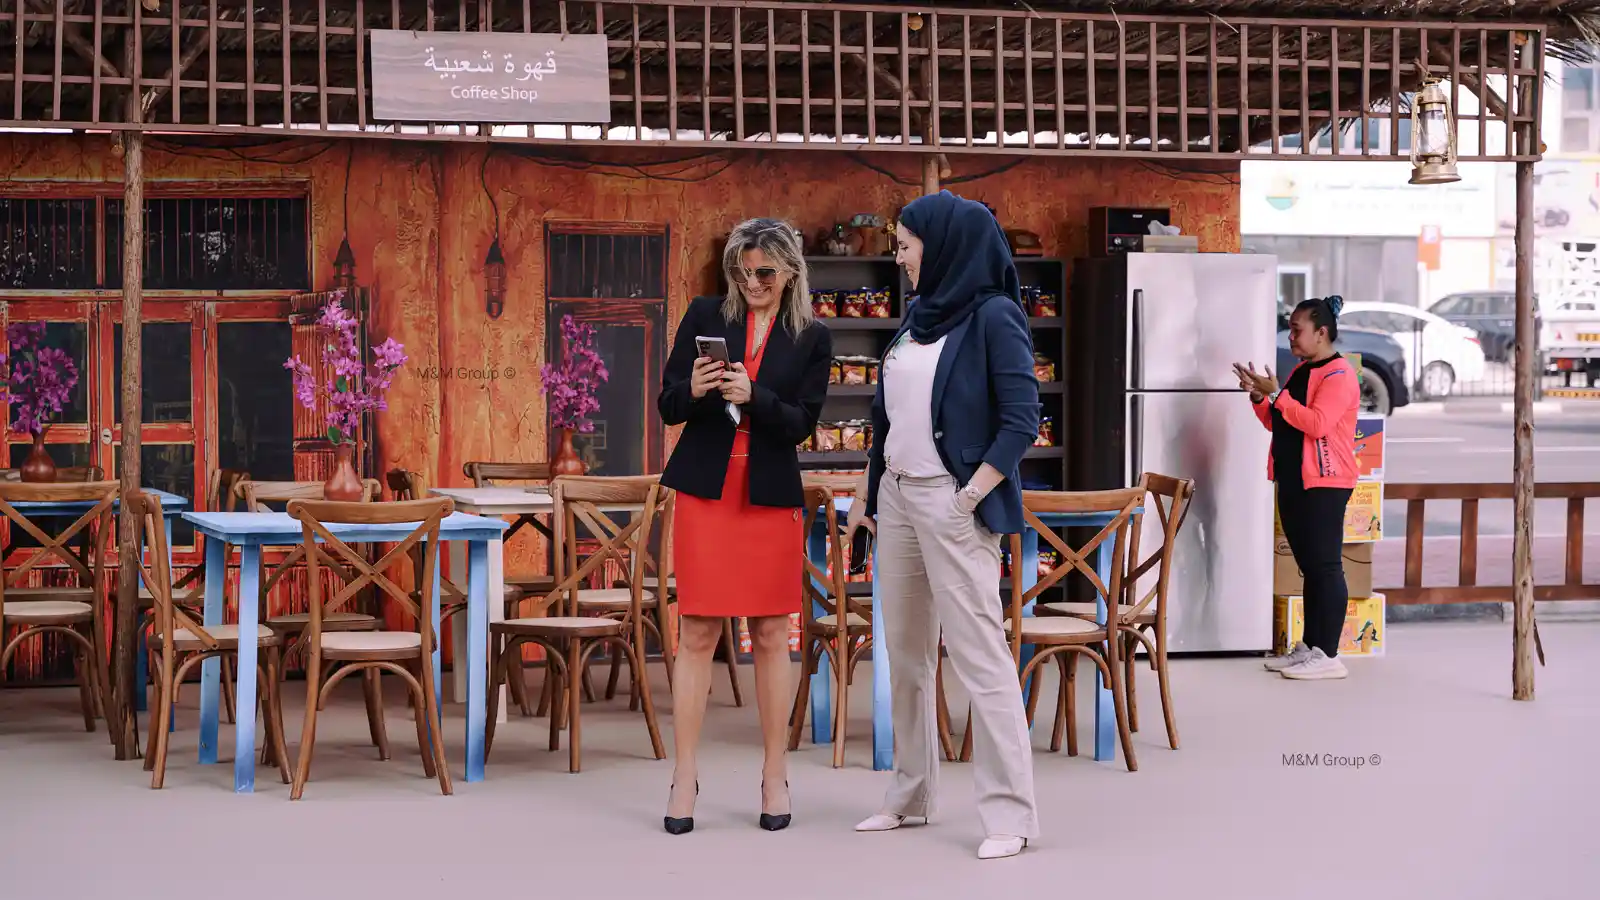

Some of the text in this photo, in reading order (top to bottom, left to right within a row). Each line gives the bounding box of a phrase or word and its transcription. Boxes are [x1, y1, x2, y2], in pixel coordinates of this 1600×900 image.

[424, 46, 557, 81] قهوة شعبية
[450, 86, 538, 103] Coffee Shop
